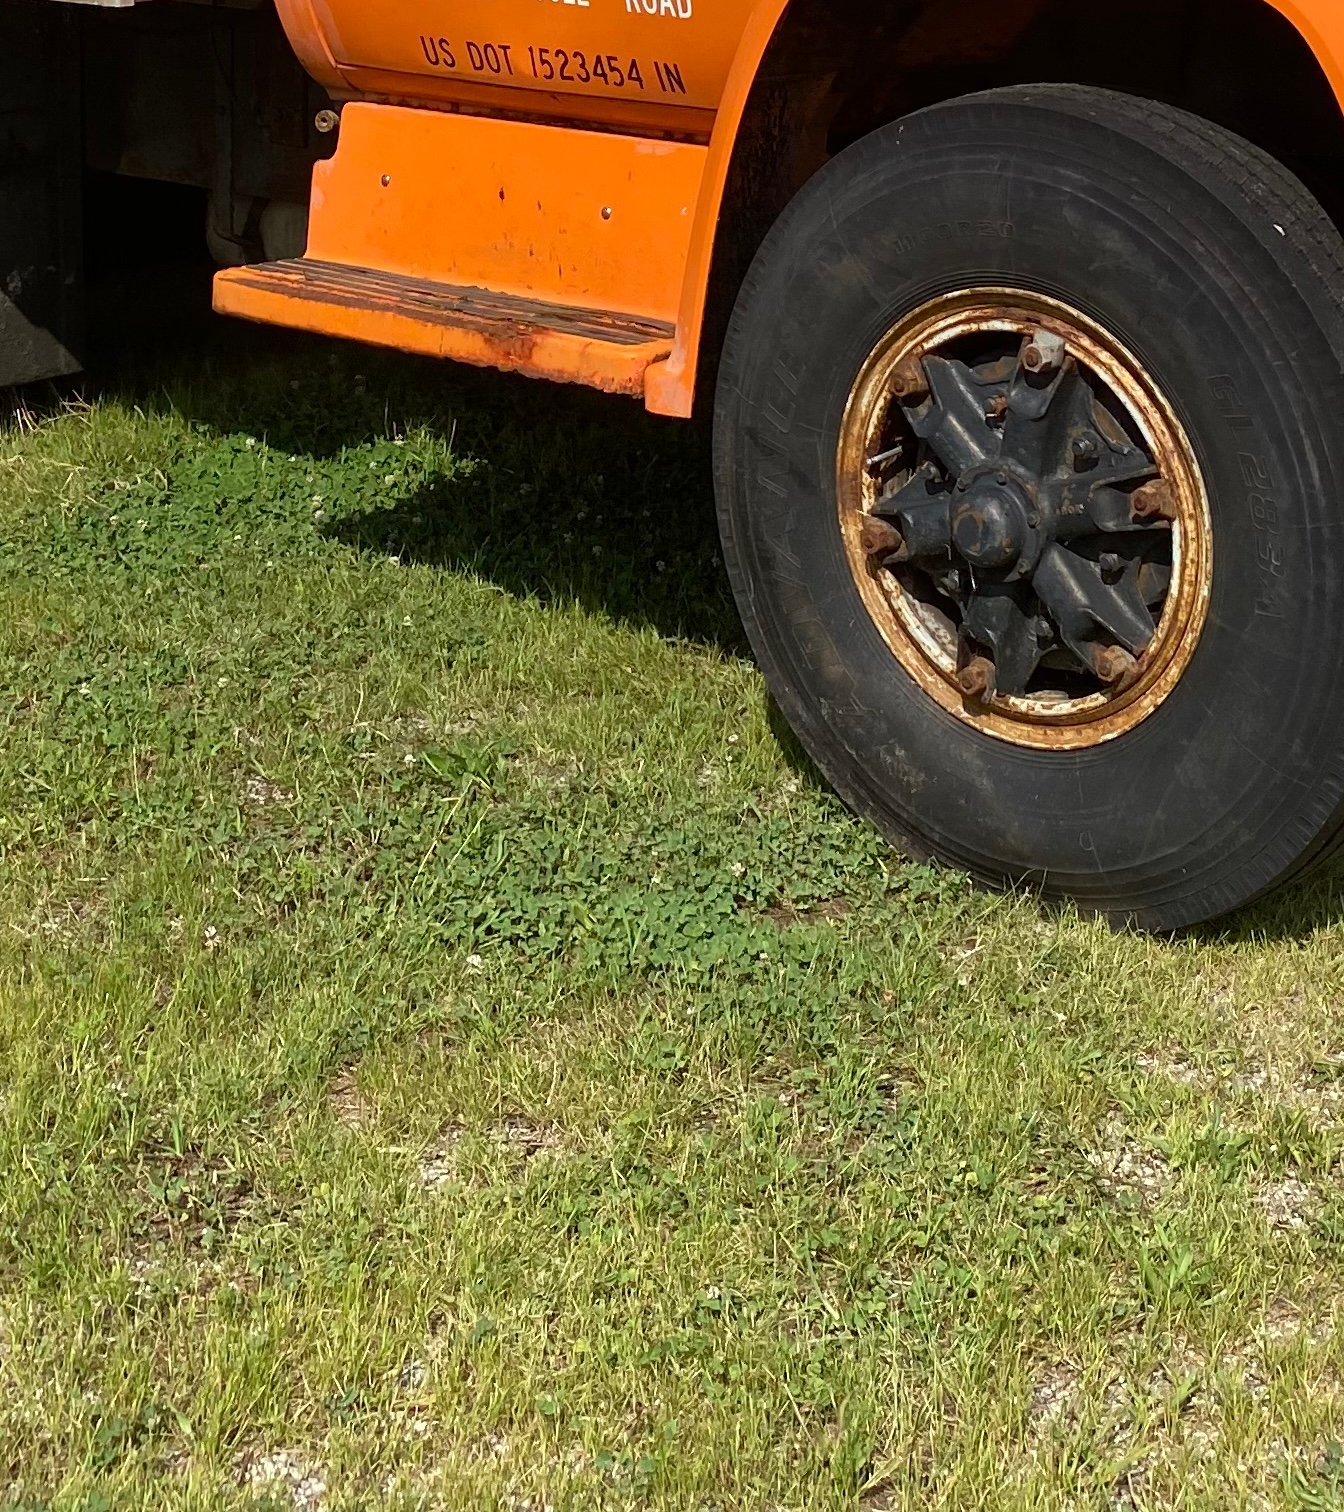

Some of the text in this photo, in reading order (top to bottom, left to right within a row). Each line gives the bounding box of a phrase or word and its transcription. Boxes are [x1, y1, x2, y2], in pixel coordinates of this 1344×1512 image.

[419, 35, 687, 95] US DOT 1523454 IN
